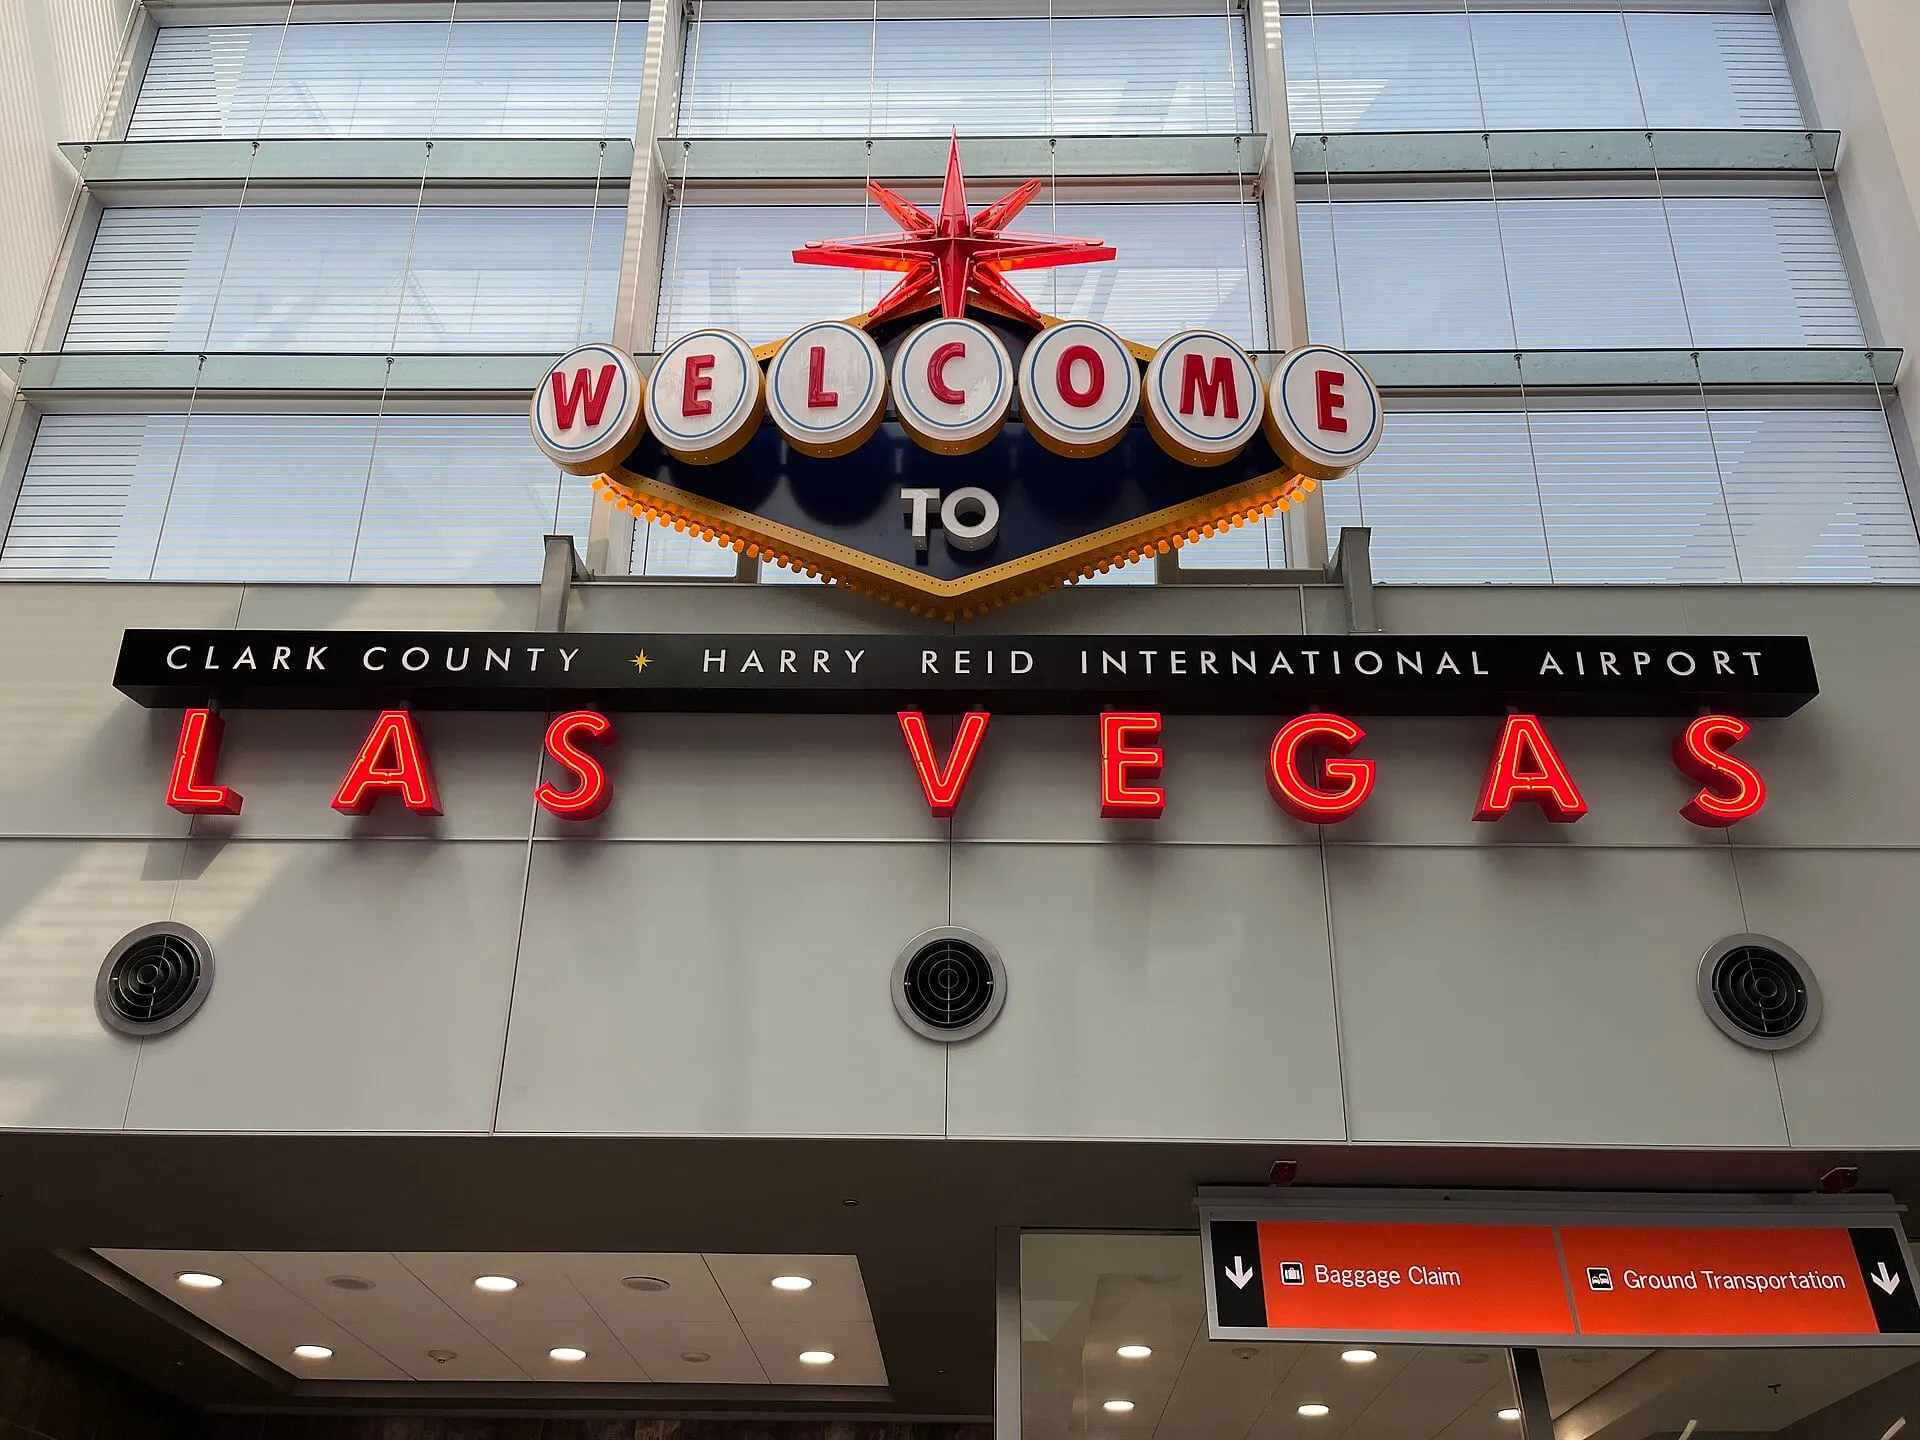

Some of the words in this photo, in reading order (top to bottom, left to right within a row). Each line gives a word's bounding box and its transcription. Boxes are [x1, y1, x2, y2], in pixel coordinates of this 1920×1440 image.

[551, 341, 1348, 434] WELCOME
[900, 487, 1000, 542] TO
[165, 645, 329, 671] CLARK
[363, 646, 580, 672] COUNTY
[702, 648, 866, 674] HARRY
[920, 649, 1035, 675] REID
[1081, 650, 1490, 676] INTERNATIONAL
[1538, 650, 1764, 677] AIRPORT
[166, 708, 615, 820] LAS
[897, 710, 1768, 827] VEGAS
[1313, 1264, 1401, 1289] Baggage
[1408, 1265, 1462, 1286] Claim
[1623, 1269, 1698, 1291] Ground
[1701, 1270, 1846, 1293] Transportation
